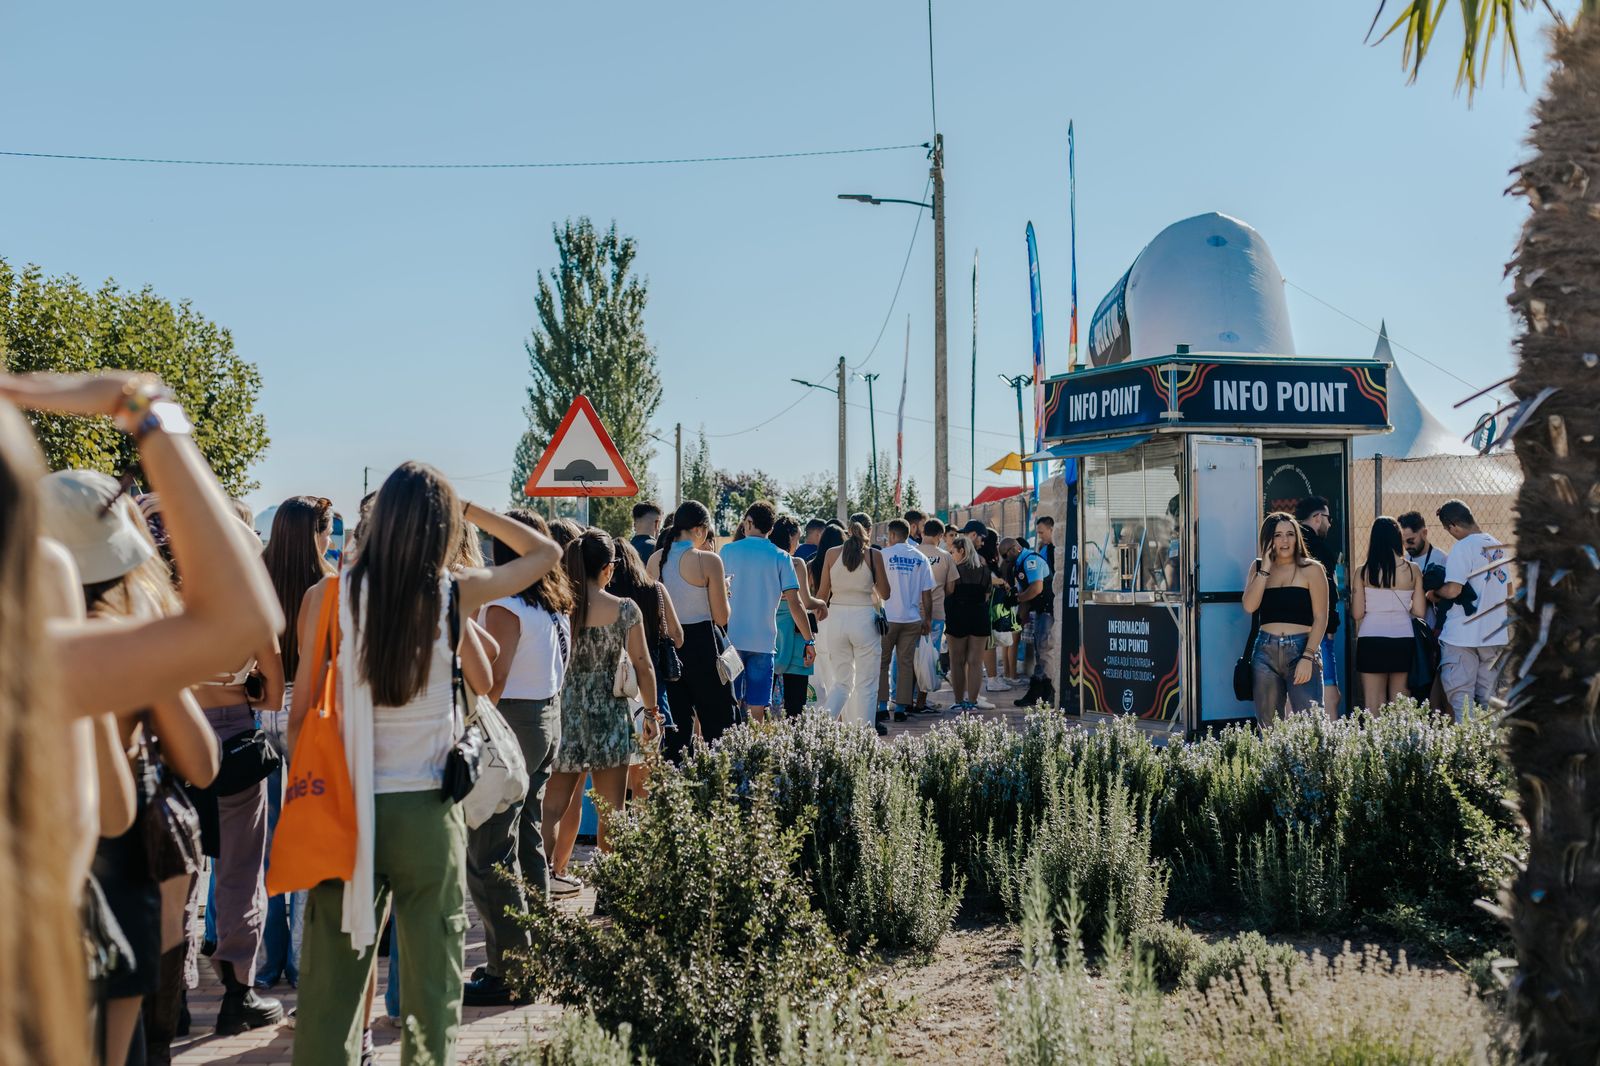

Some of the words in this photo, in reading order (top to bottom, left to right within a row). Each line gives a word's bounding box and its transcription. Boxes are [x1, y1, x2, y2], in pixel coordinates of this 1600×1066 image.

[1069, 391, 1098, 422] INFO
[1101, 385, 1141, 418] POINT
[1213, 380, 1268, 411] INFO
[1276, 381, 1348, 412] POINT
[1108, 617, 1150, 635] INFORMACIÓN
[1110, 638, 1118, 651] EN
[1118, 638, 1127, 652] SU
[1128, 638, 1149, 653] PUNTO
